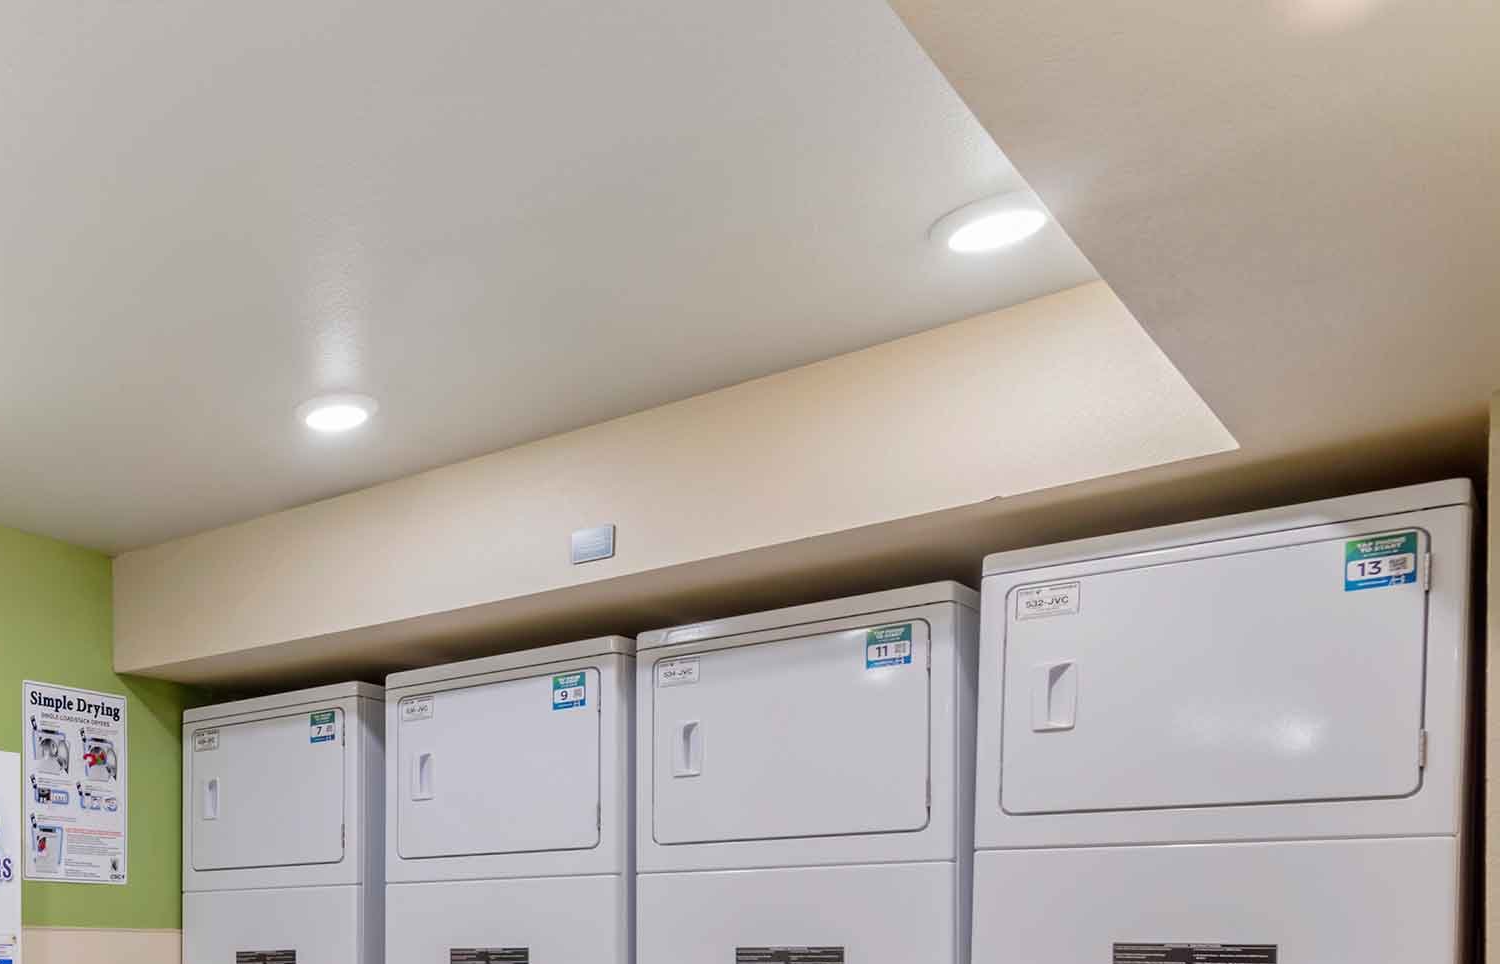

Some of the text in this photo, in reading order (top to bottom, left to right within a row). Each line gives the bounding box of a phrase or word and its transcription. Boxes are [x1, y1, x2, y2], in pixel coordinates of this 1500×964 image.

[1356, 560, 1382, 577] 13
[1025, 595, 1069, 609] 532-JVC
[876, 645, 888, 658] 11
[560, 690, 568, 701] 9
[30, 691, 120, 722] Simple Drying
[316, 726, 322, 735] 7
